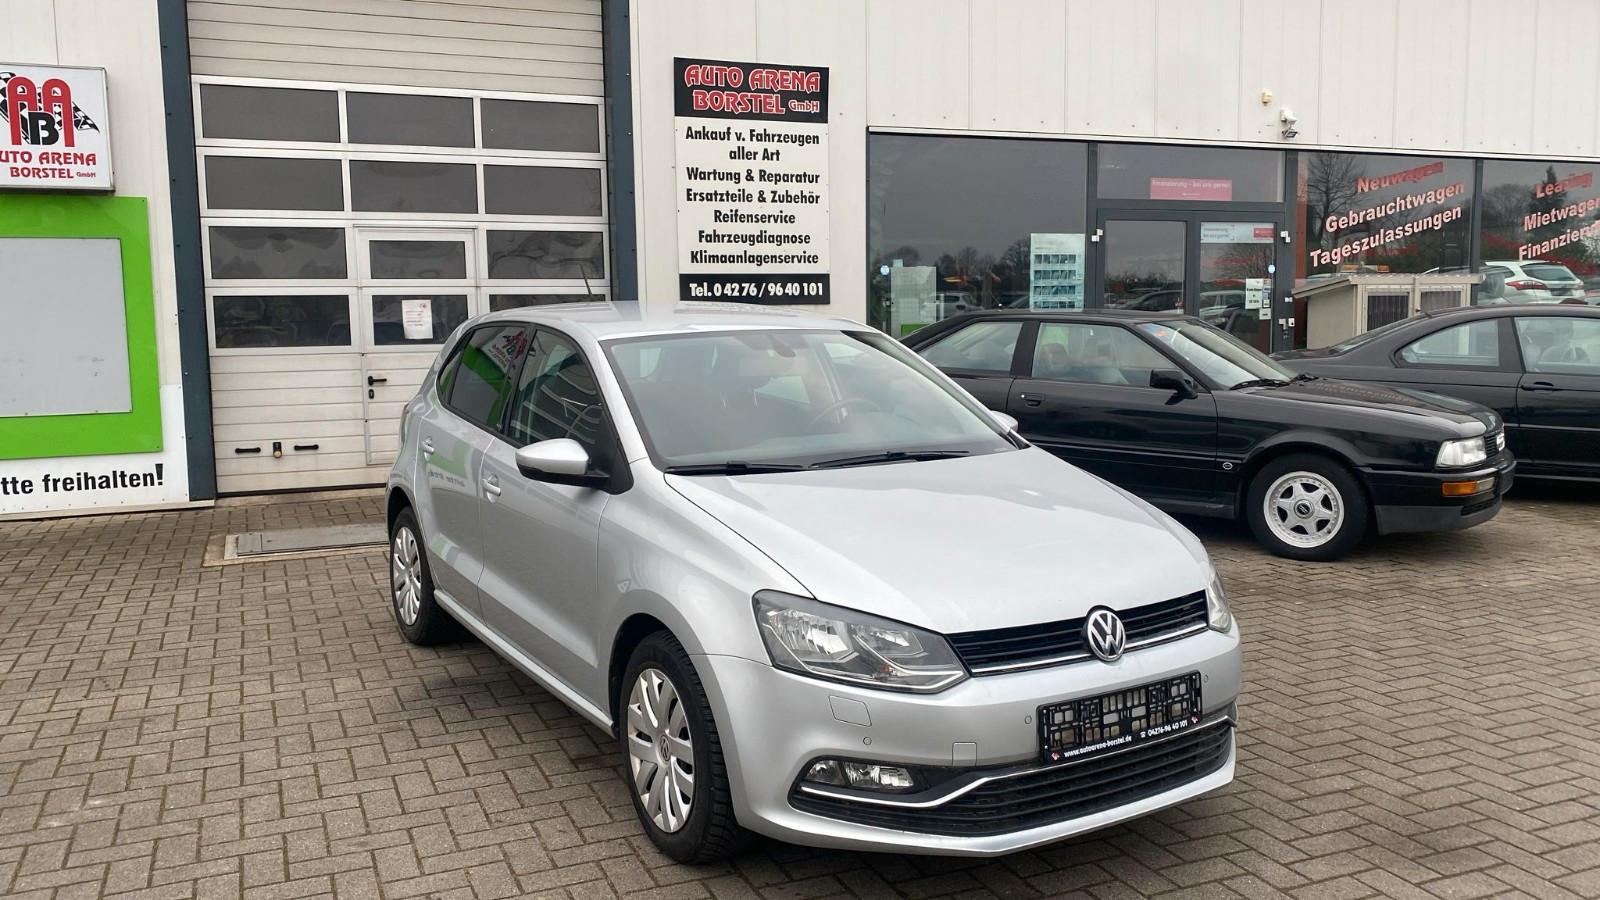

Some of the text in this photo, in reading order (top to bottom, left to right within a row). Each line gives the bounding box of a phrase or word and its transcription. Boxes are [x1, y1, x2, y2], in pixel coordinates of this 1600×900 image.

[684, 64, 821, 94] AUTO ARENA
[692, 89, 820, 115] BORSTEL GmbH
[685, 126, 820, 146] Ankauf v. Fahrzeugen
[38, 151, 97, 166] ARENA
[728, 146, 781, 161] aller Art
[10, 166, 74, 179] BORSTEL
[686, 166, 821, 186] Wartung & Reparatur
[686, 188, 821, 205] Ersatzteile & Zubehör
[1324, 181, 1465, 233] Gebrauchtwagen
[713, 209, 797, 224] Reifenservice
[698, 229, 811, 247] Fahrzeugdiagnose
[1309, 205, 1463, 267] Tageszulassungen
[690, 250, 819, 267] Klimaanlagenservice
[689, 282, 712, 297] Tel.
[42, 463, 164, 493] freihalten!
